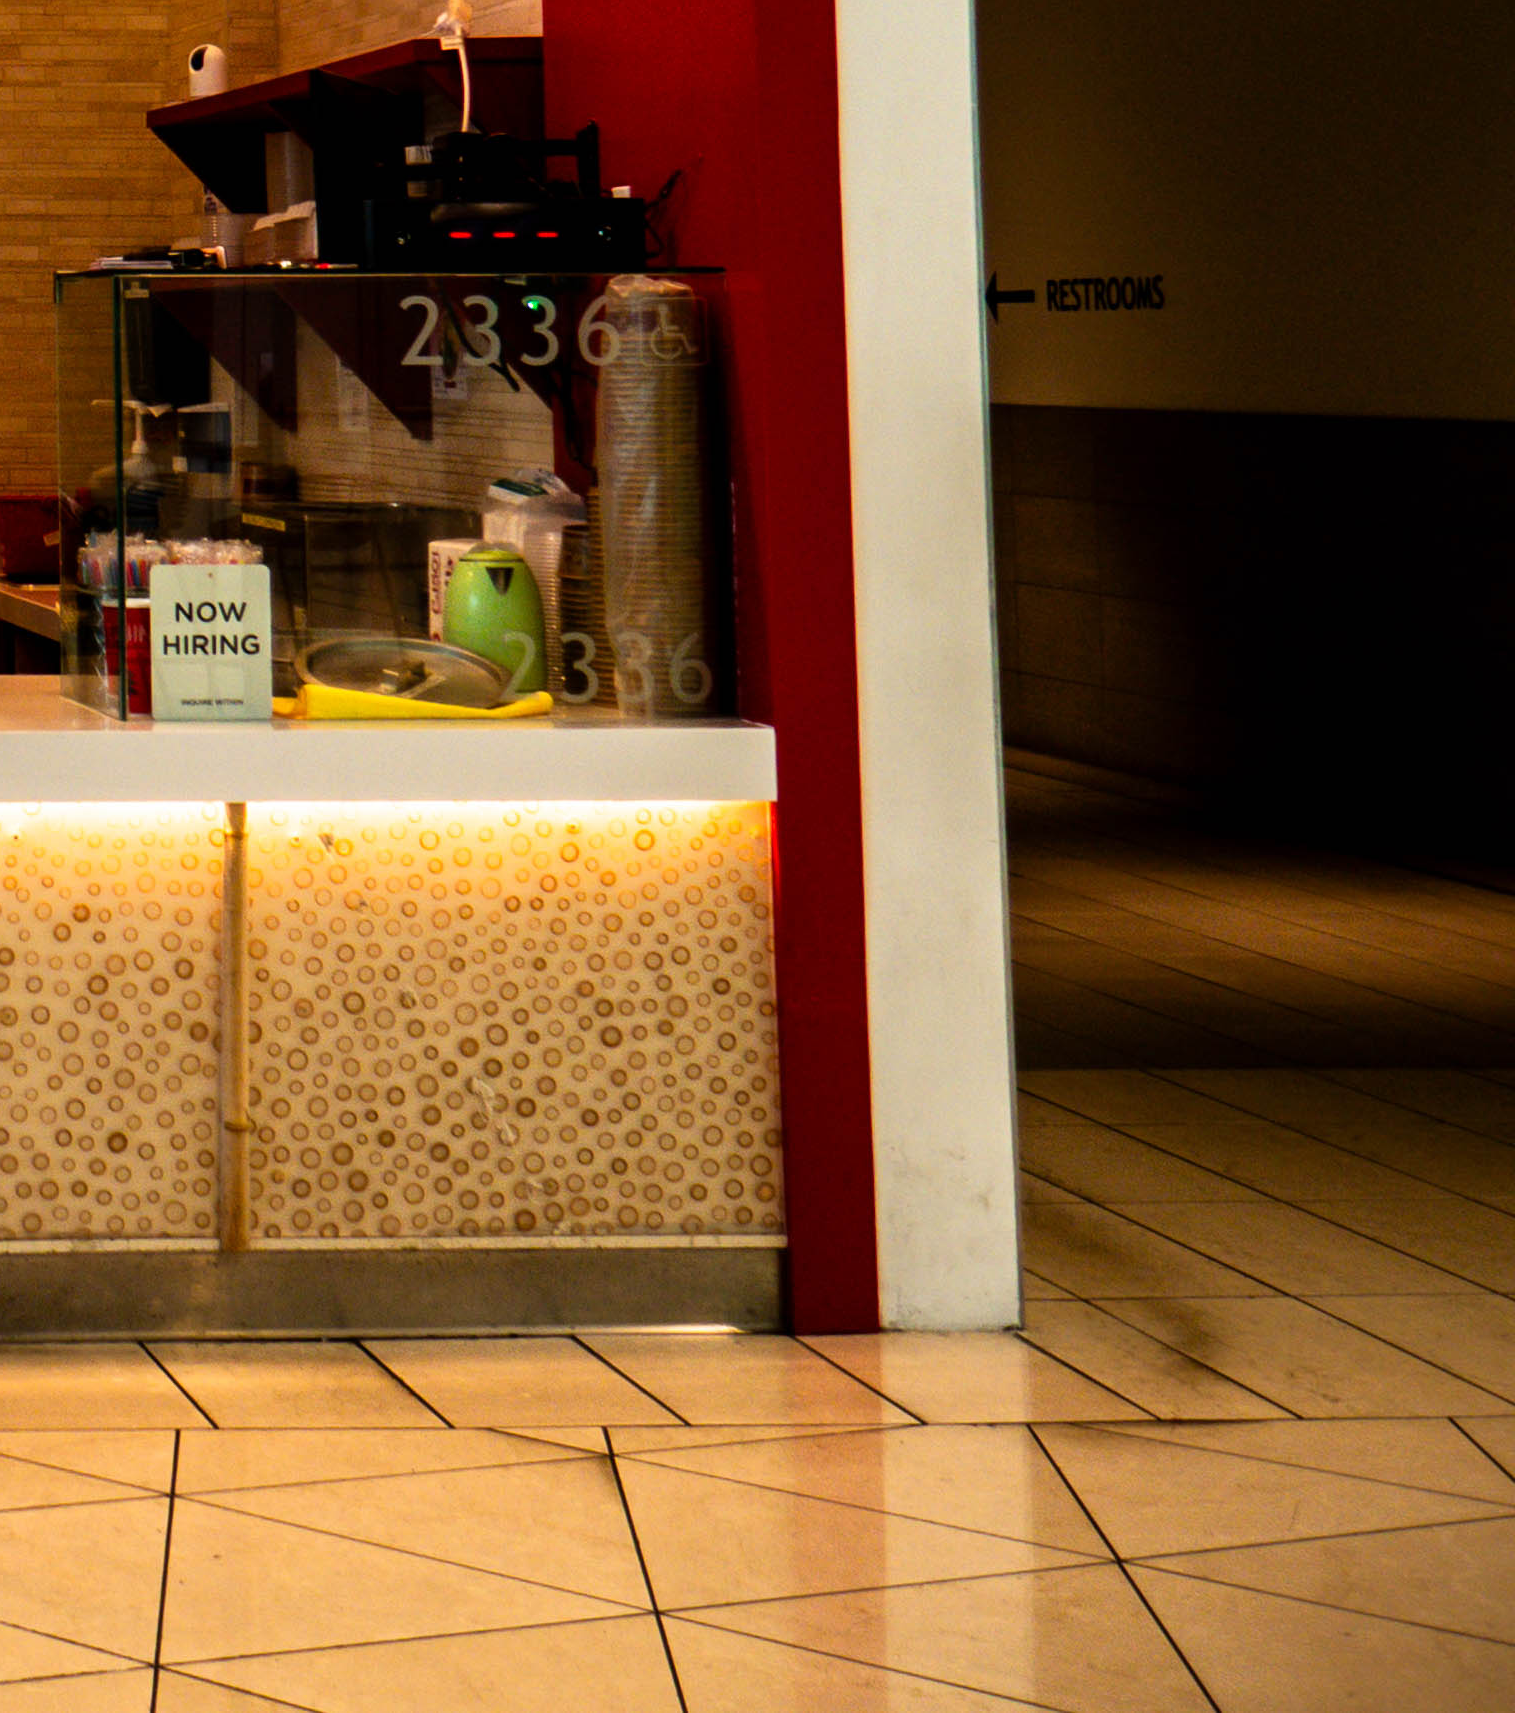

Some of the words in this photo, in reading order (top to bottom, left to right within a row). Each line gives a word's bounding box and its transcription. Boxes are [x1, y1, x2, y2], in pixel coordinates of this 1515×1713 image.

[1046, 274, 1165, 312] RESTROOMS
[399, 295, 620, 367] 2336
[175, 602, 247, 623] NOW
[163, 634, 260, 655] HIRING
[500, 631, 713, 704] 2336
